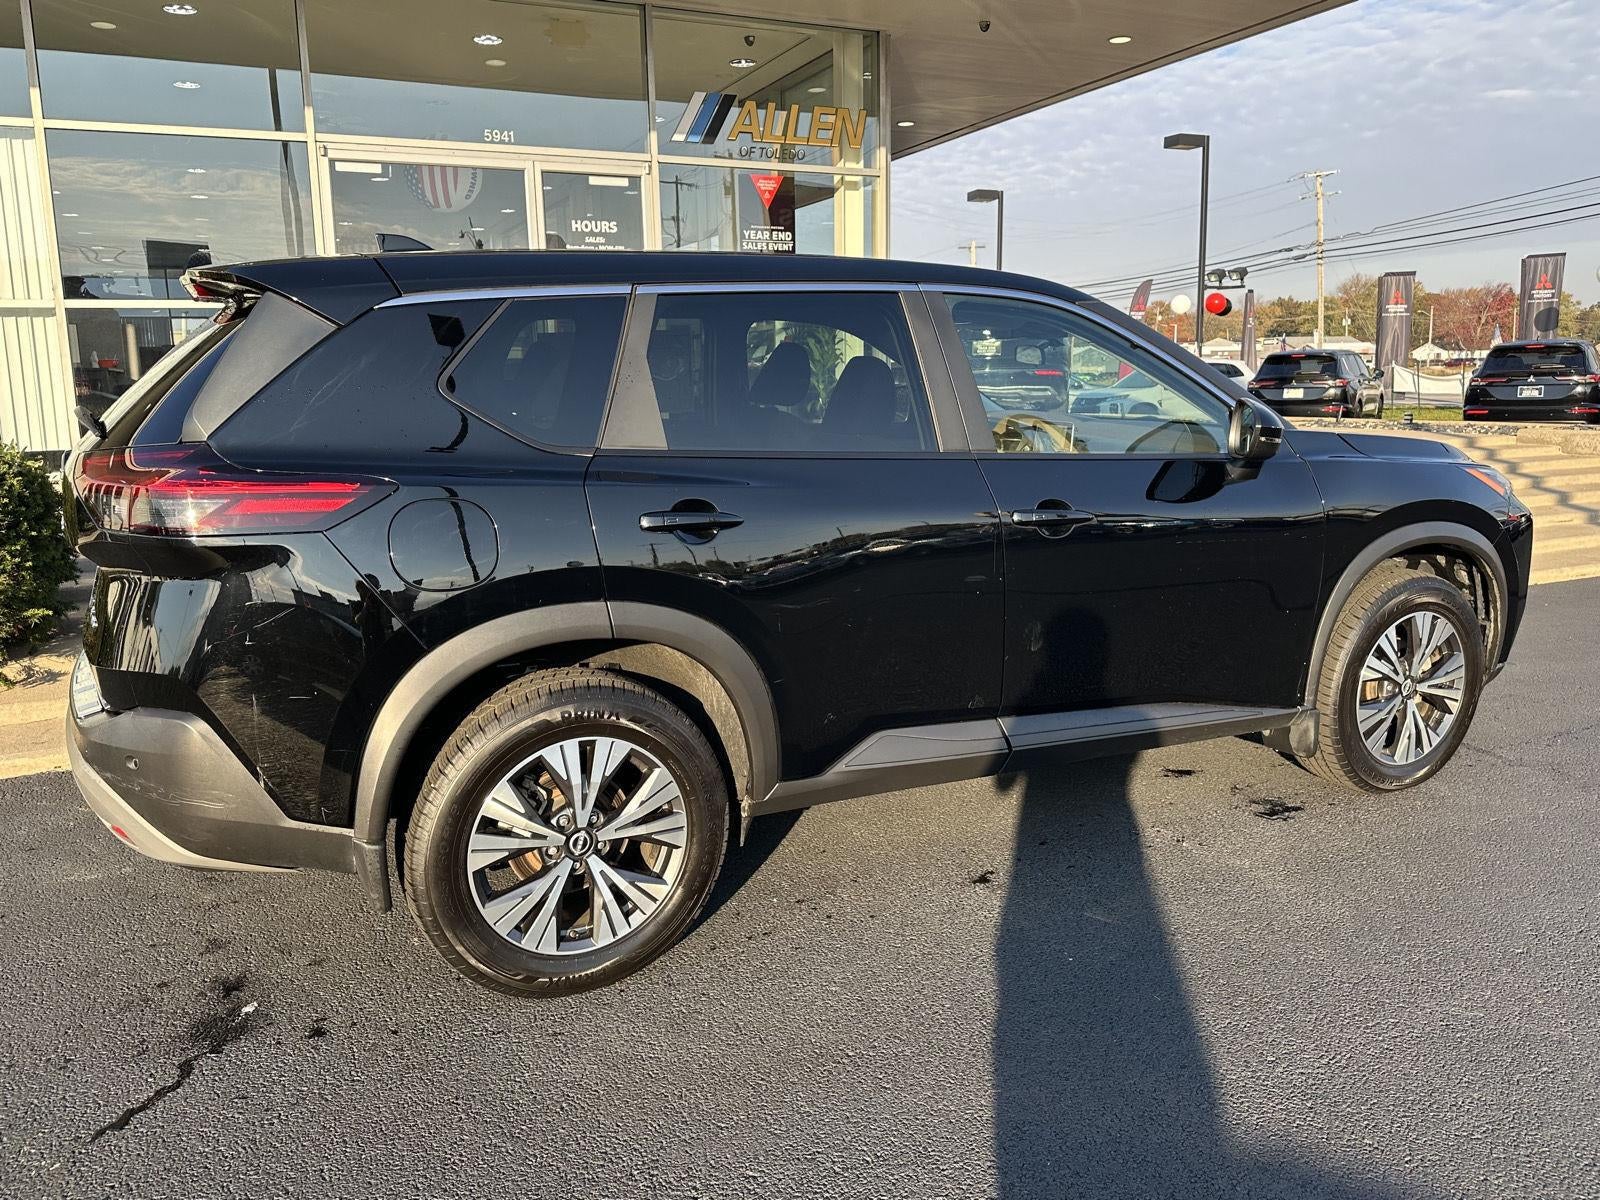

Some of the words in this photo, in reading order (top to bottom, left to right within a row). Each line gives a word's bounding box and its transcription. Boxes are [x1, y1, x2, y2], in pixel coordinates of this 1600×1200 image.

[727, 100, 867, 149] ALLEN
[484, 129, 515, 143] 5941
[740, 146, 756, 157] OF
[759, 147, 805, 160] TOLEDO
[571, 219, 618, 233] HOURS
[743, 230, 770, 240] YEAR
[772, 231, 792, 241] END
[742, 242, 767, 250] SALES
[768, 243, 794, 251] EVENT
